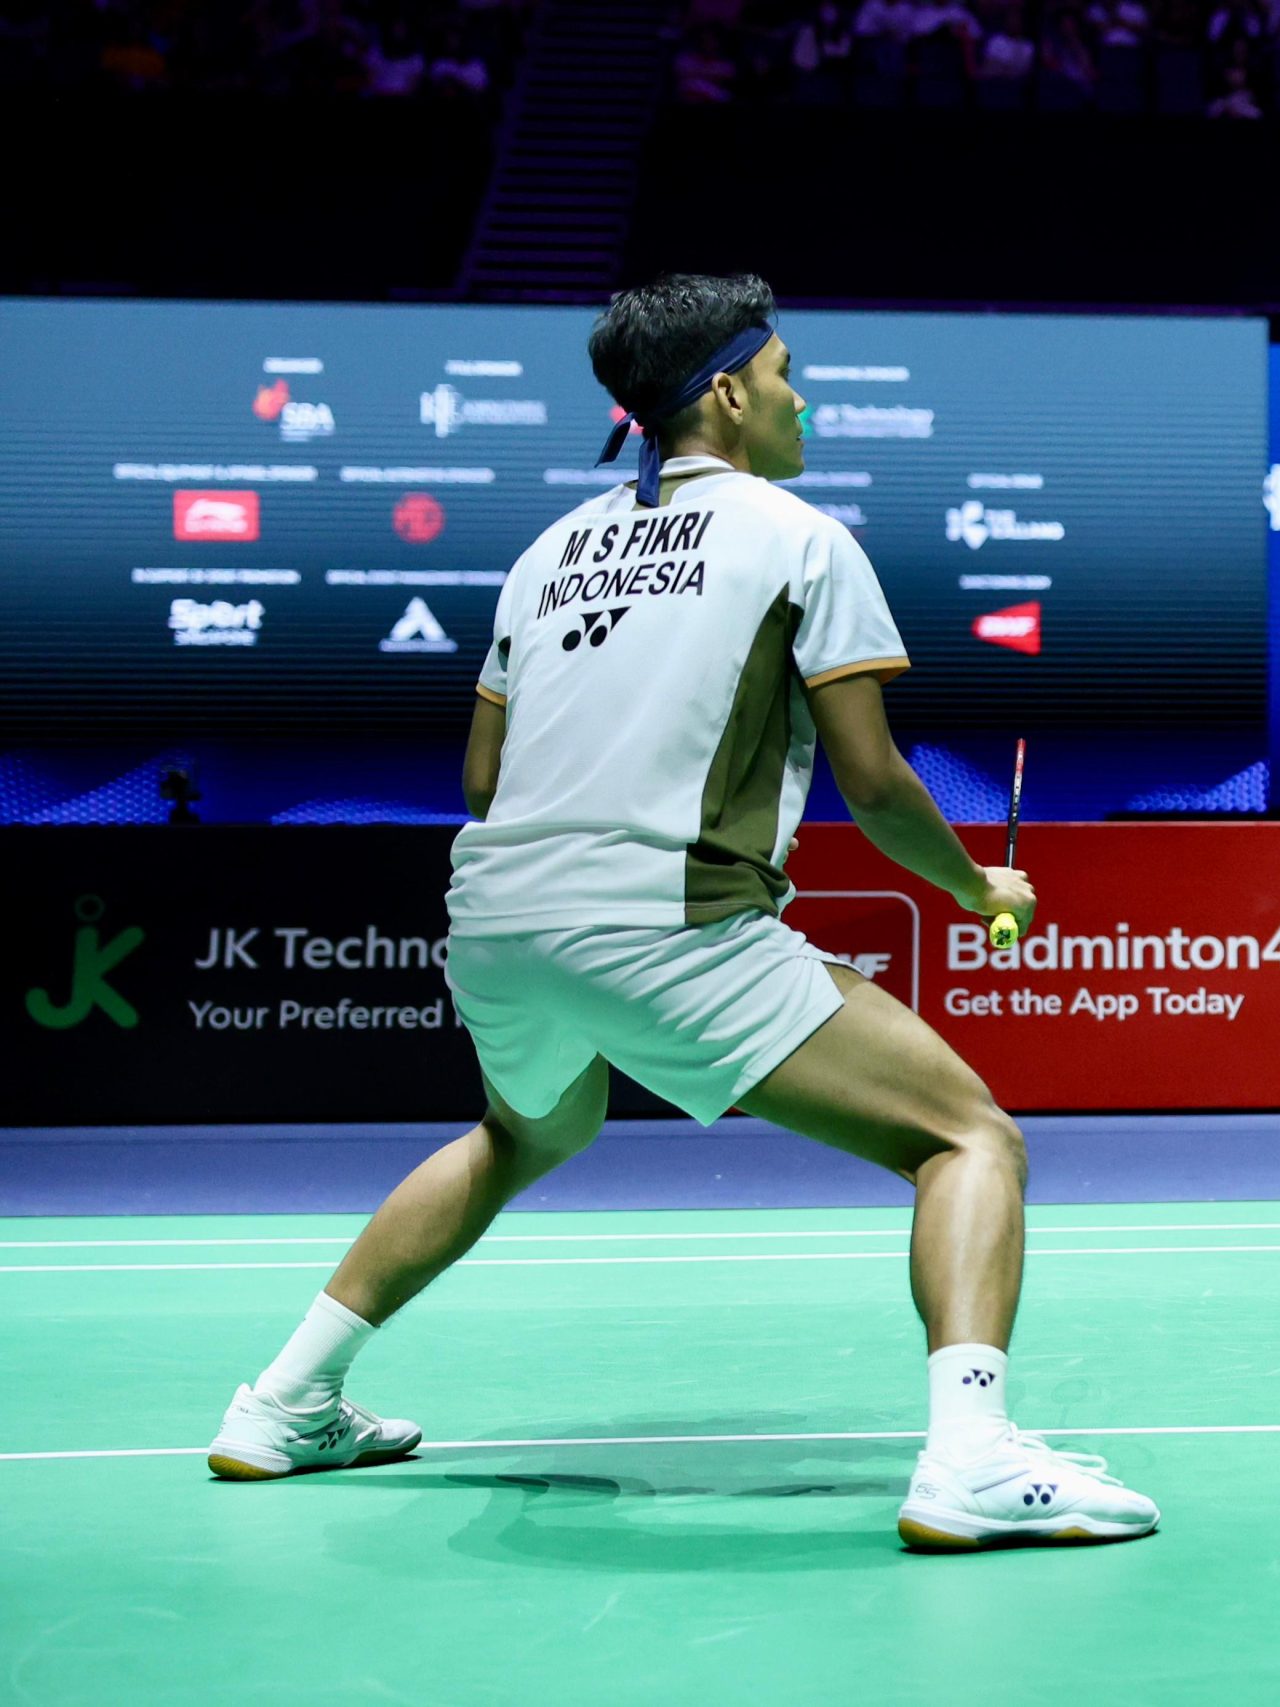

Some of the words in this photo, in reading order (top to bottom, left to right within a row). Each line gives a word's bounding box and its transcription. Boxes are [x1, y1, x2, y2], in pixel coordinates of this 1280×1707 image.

[558, 529, 592, 569] M
[593, 524, 619, 563] S
[620, 511, 714, 560] FIKRI
[537, 560, 704, 619] INDONESIA
[195, 927, 259, 969] JK
[188, 1000, 270, 1030] Your
[280, 999, 443, 1030] Preferred
[945, 988, 1004, 1016] Get
[1009, 987, 1062, 1015] the
[1070, 988, 1139, 1020] App
[1146, 987, 1244, 1020] Today
